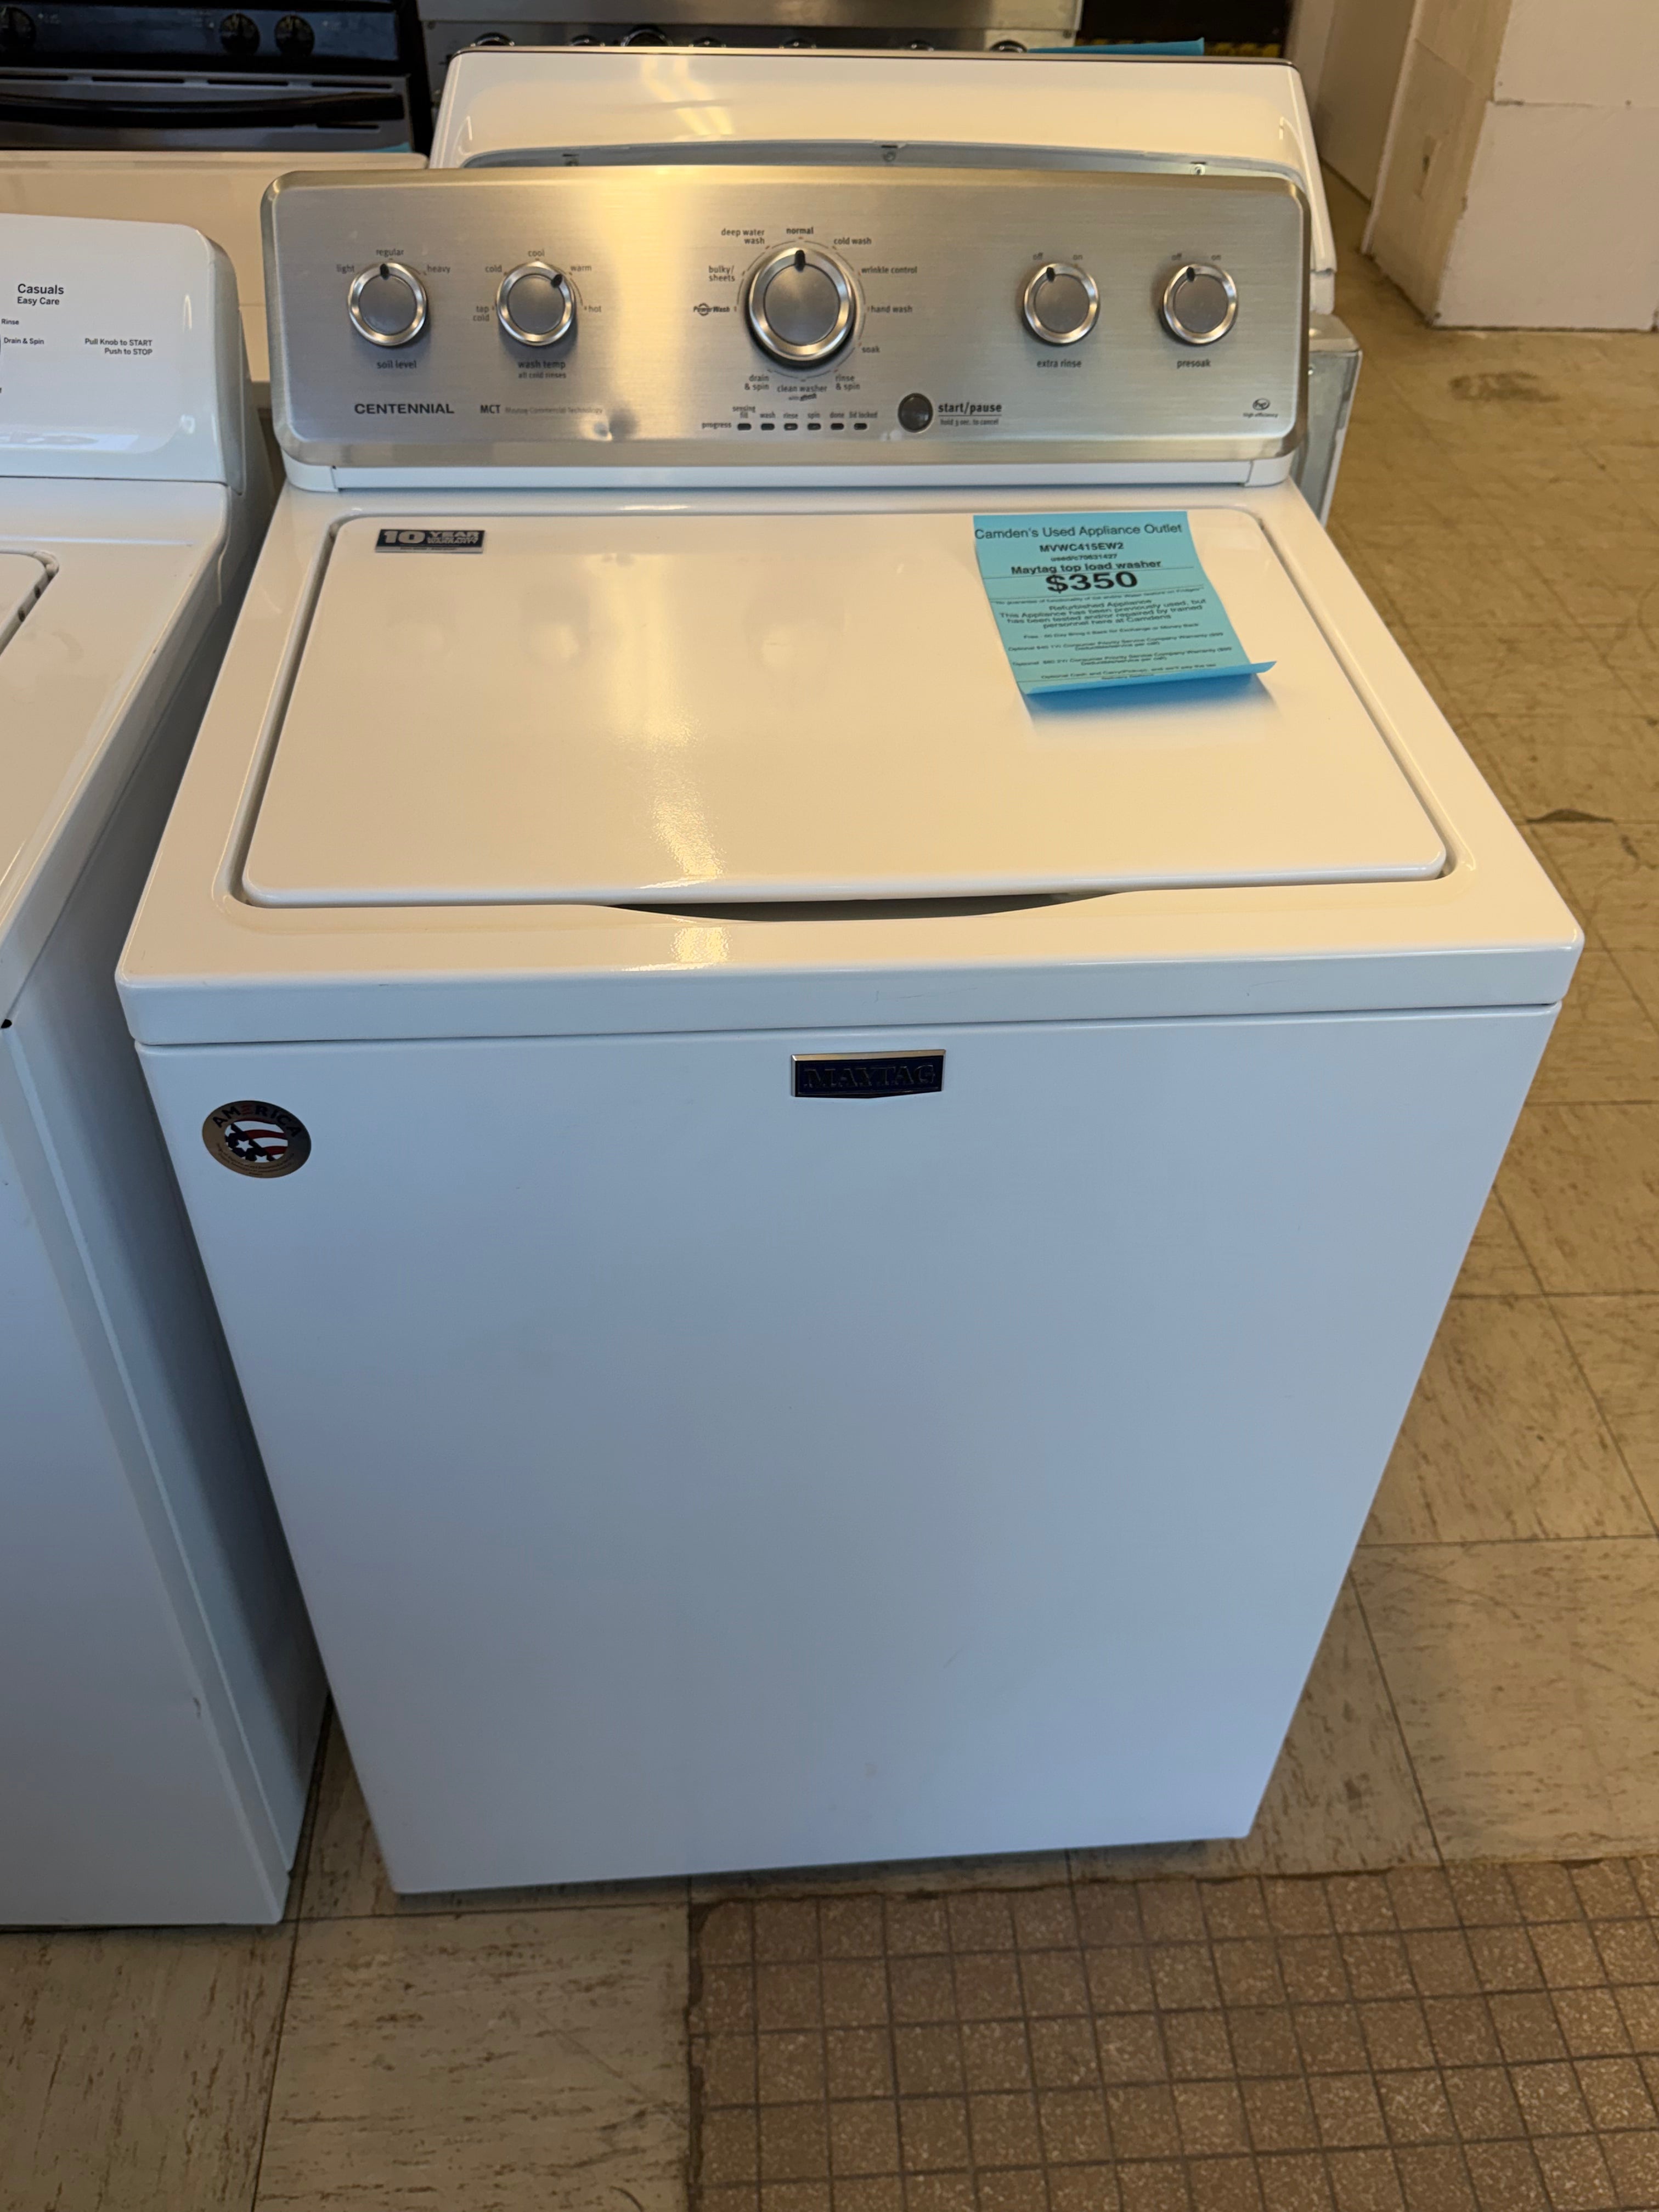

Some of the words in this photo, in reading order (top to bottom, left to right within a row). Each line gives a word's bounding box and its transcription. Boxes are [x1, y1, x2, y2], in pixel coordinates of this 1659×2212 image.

[721, 229, 741, 237] deep
[376, 249, 404, 257] regular
[336, 264, 355, 274] light
[427, 264, 450, 273] heavy
[709, 266, 734, 275] bulky/
[18, 283, 64, 295] Casuals
[17, 296, 37, 306] Easy
[476, 305, 489, 314] tap
[473, 314, 489, 322] cold
[377, 360, 393, 369] soil
[395, 360, 417, 369] level
[518, 360, 541, 369] wash
[543, 361, 566, 370] temp
[1037, 359, 1058, 368] extra
[1060, 359, 1082, 368] rinse
[1177, 359, 1210, 369] presoak
[354, 403, 455, 414] CENTENNIAL
[480, 404, 500, 414] MCT
[938, 402, 1002, 415] start/pause
[974, 527, 1039, 539] Camden's
[1043, 527, 1075, 537] Used
[1079, 525, 1141, 537] Appliance
[1144, 523, 1182, 534] Outlet
[384, 531, 425, 544] 10
[1039, 542, 1124, 552] MVWC415EW2
[1011, 566, 1057, 575] Maytag
[1060, 565, 1082, 573] top
[1085, 562, 1112, 571] load
[1115, 560, 1161, 569] washer
[1046, 571, 1138, 594] $350
[1107, 599, 1152, 608] Appliance
[1115, 604, 1161, 613] previously
[1116, 610, 1154, 618] repaired
[1170, 605, 1203, 613] trained
[1043, 620, 1089, 629] personnel
[803, 1064, 935, 1088] MAYTAG
[212, 1104, 302, 1137] AMERICA
